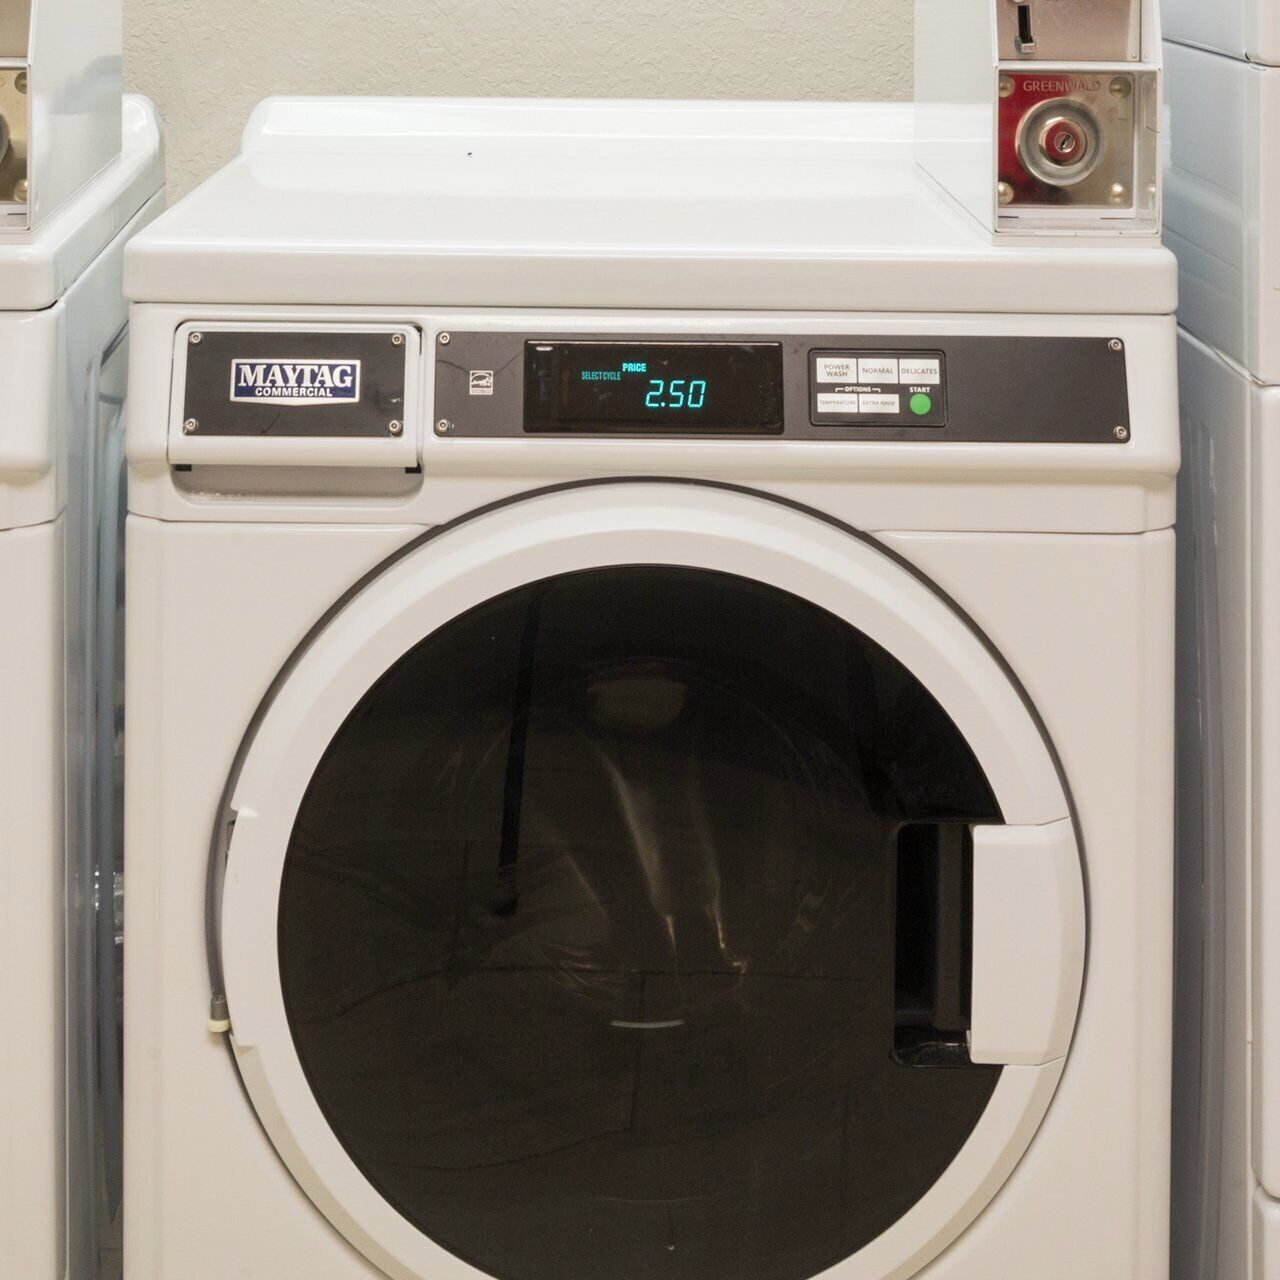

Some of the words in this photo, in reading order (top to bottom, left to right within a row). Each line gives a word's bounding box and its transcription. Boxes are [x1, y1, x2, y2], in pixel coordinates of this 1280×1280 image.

[1023, 80, 1100, 92] GREENWALD
[622, 363, 647, 372] PRICE
[238, 364, 353, 388] MAYTAG
[581, 371, 603, 380] SELECT
[602, 371, 621, 380] CYCLE
[255, 387, 333, 397] COMMERCIAL
[645, 380, 706, 407] 2.50
